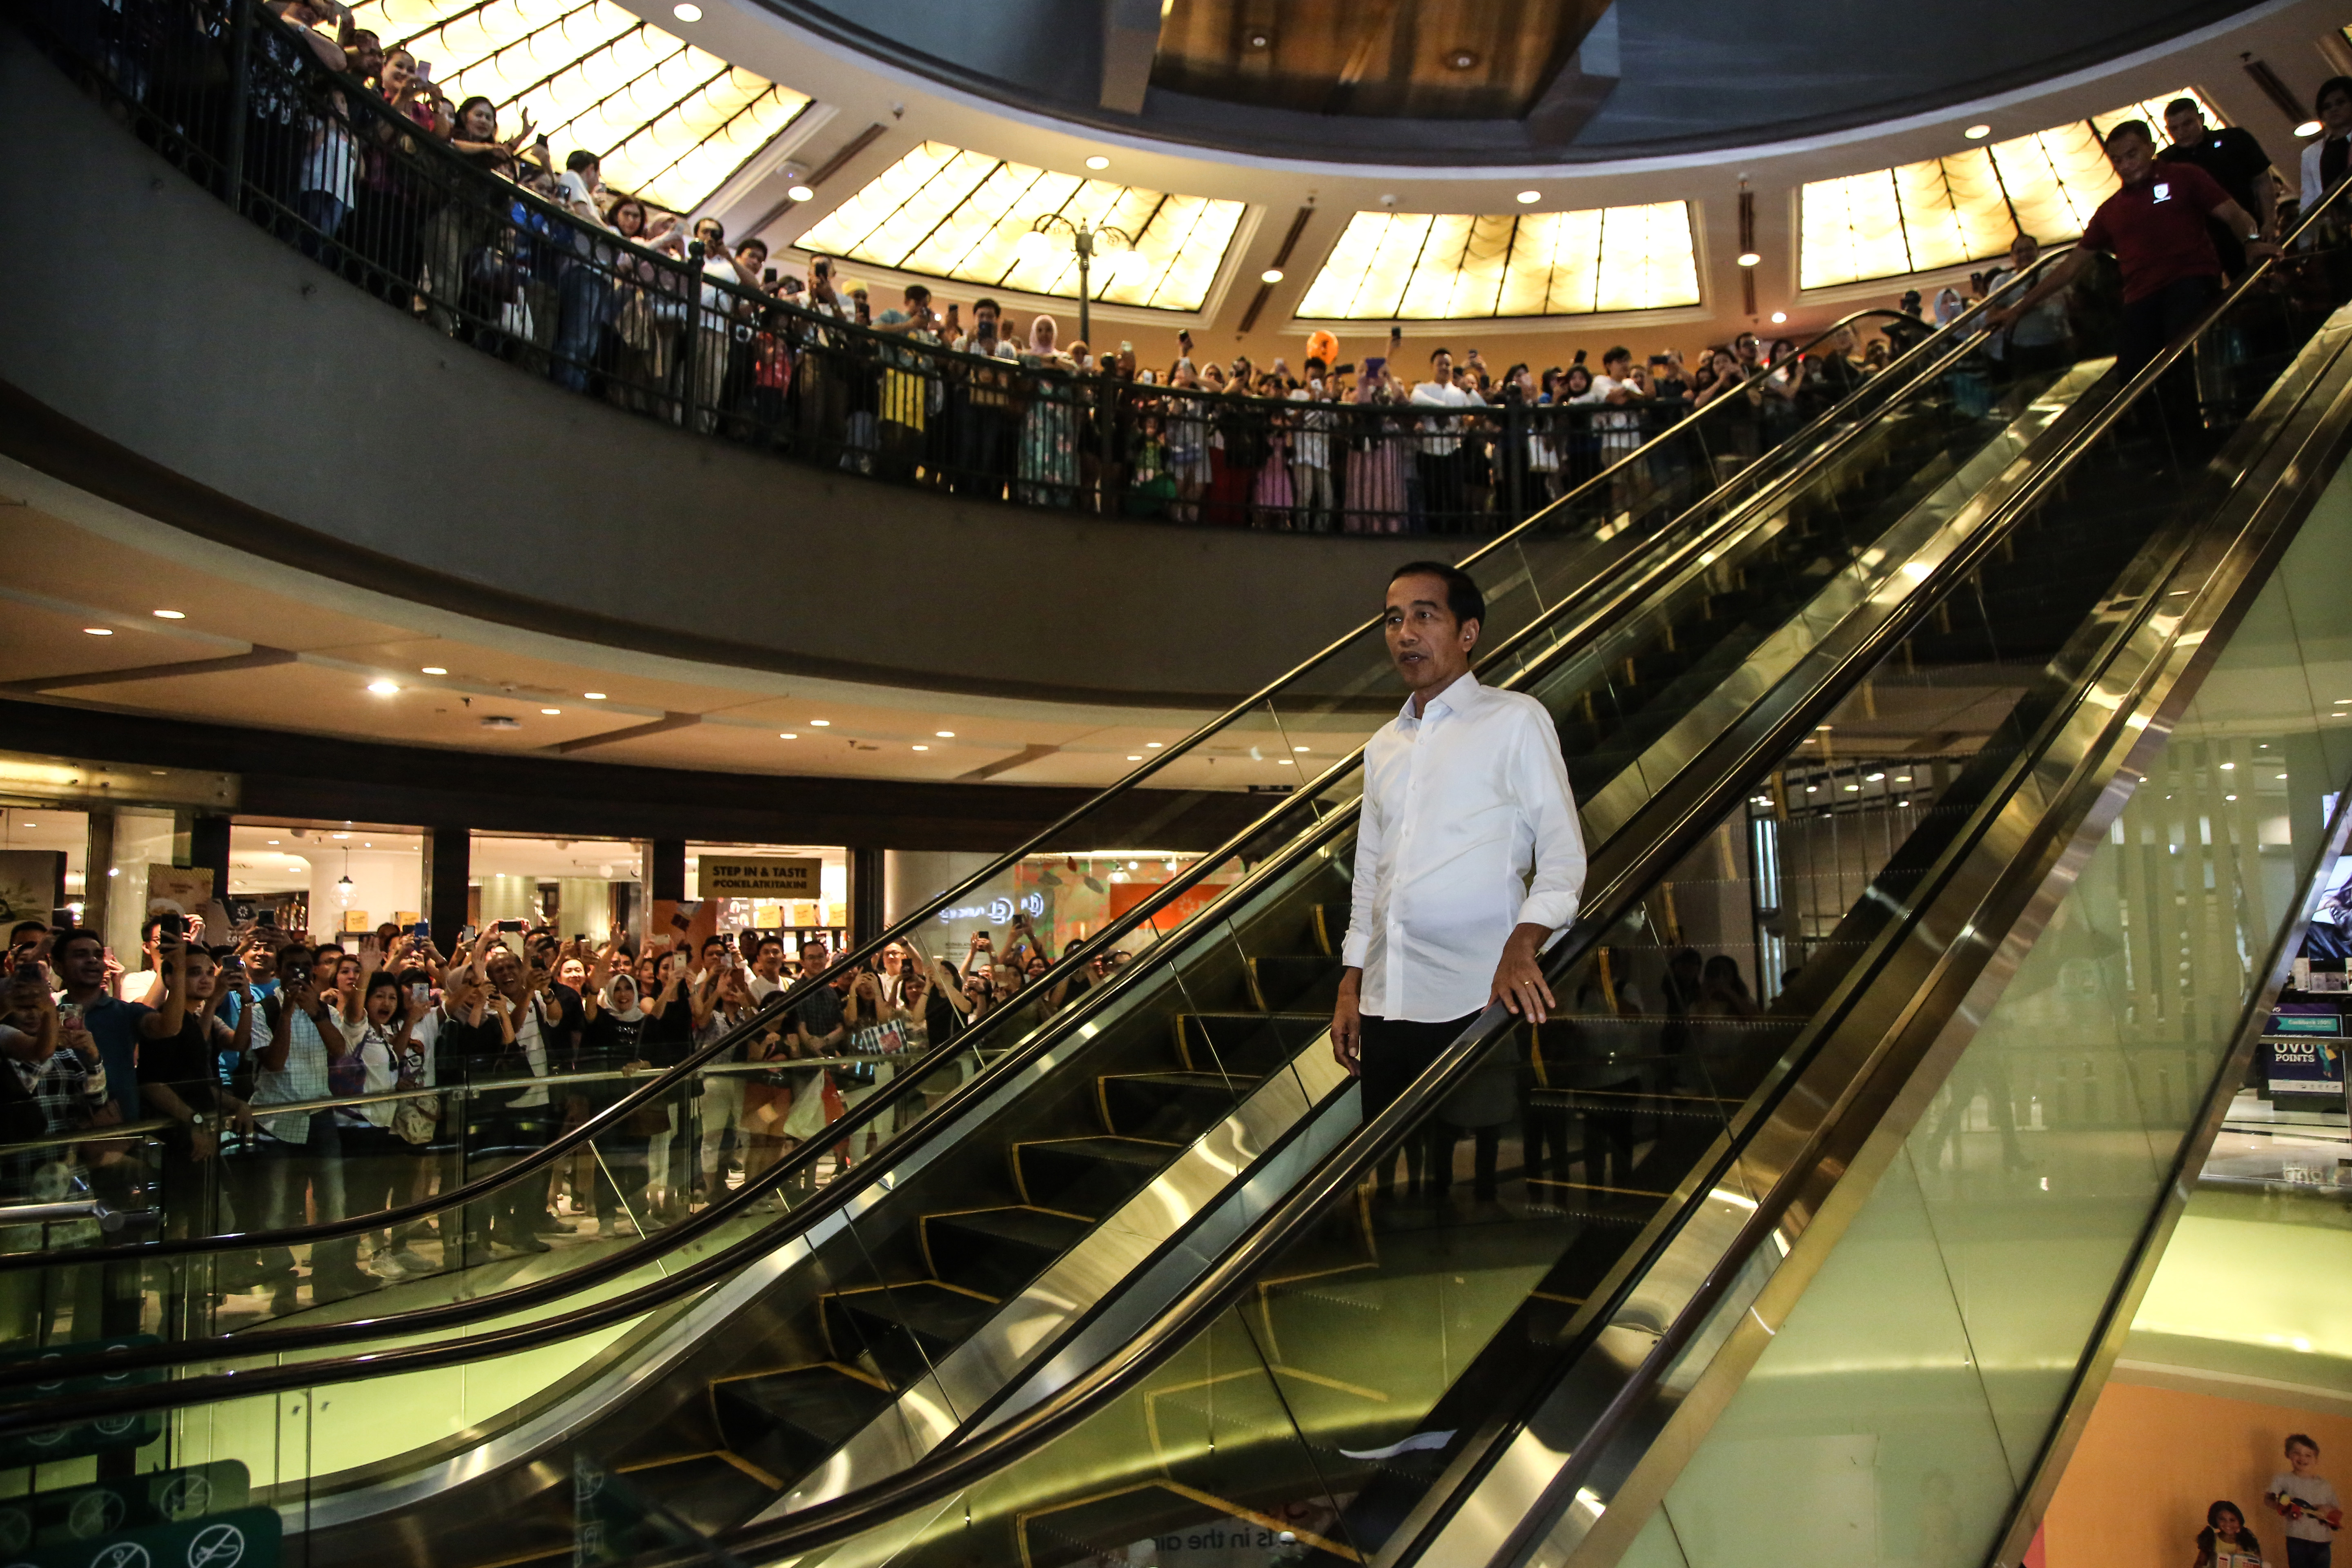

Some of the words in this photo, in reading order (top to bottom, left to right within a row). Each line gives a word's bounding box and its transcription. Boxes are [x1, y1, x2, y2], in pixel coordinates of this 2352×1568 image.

[713, 866, 741, 876] STEP
[744, 866, 757, 876] IN
[760, 867, 769, 877] &
[772, 867, 807, 878] TASTE
[2274, 1042, 2315, 1054] OVO
[2275, 1054, 2315, 1062] POINTS
